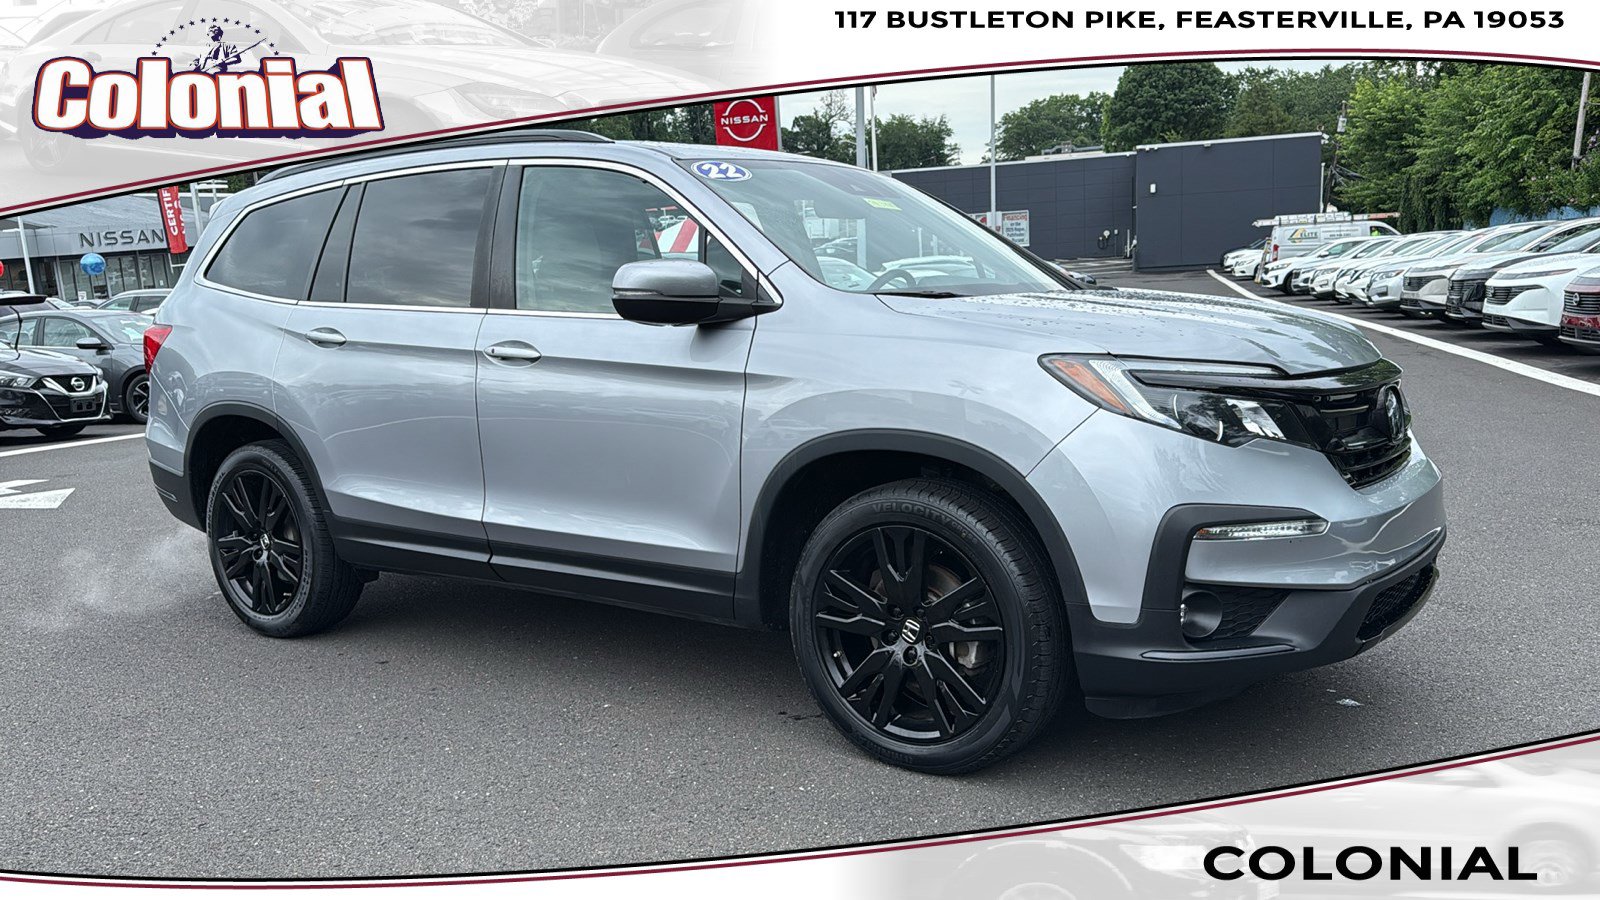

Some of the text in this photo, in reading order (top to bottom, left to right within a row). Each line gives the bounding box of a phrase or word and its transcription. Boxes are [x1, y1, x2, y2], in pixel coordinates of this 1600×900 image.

[720, 114, 768, 125] NISSAN
[701, 163, 744, 179] 22
[79, 229, 165, 247] NISSAN
